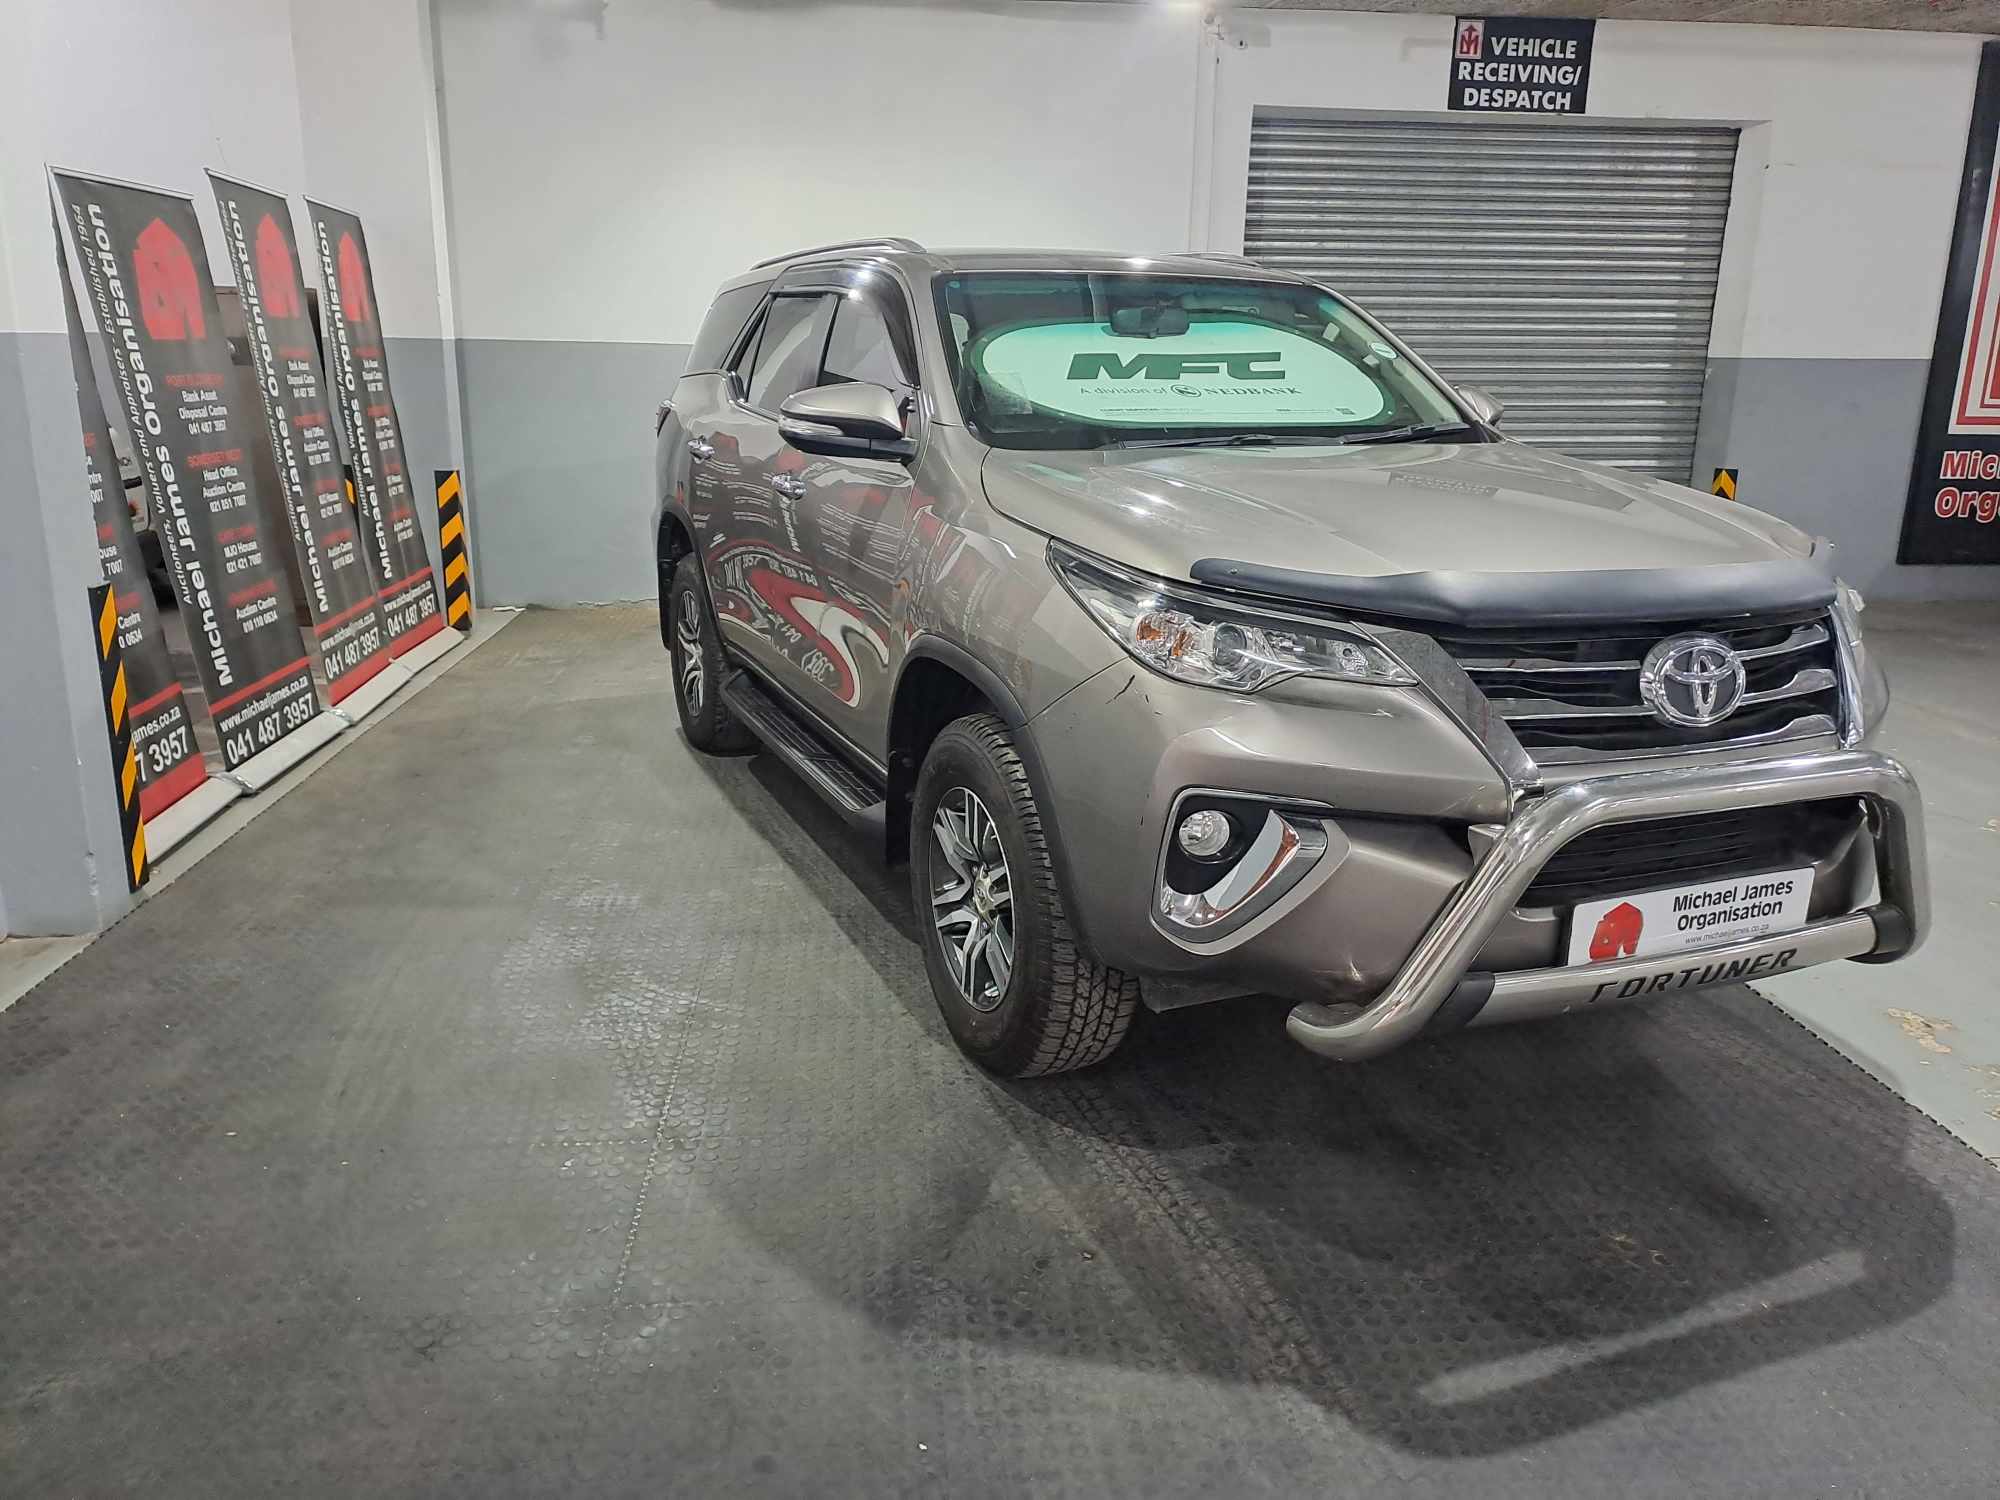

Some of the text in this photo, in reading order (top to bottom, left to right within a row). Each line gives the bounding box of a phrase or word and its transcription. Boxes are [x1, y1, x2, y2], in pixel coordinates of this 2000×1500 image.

[1457, 61, 1583, 86] RECEIVING/
[1490, 37, 1578, 59] VEHICLE
[1463, 87, 1572, 111] DESPATCH
[71, 203, 89, 242] 1964
[83, 247, 115, 335] Established
[228, 200, 279, 397] Organisation
[317, 221, 355, 391] Organisation
[87, 203, 162, 436] Organisation
[111, 347, 142, 426] Appraisers
[1066, 351, 1286, 381] MFC
[1201, 385, 1303, 396] NEDBANK
[133, 428, 150, 457] and
[275, 405, 303, 497] James
[350, 398, 374, 479] James
[145, 461, 166, 514] Valuers
[1940, 450, 2000, 480] Mic
[156, 445, 196, 551] James
[1935, 486, 2000, 523] Org
[365, 484, 393, 579] Michael
[296, 504, 329, 613] Michael
[117, 611, 142, 629] Centre
[185, 559, 233, 687] Michael
[387, 593, 436, 638] 041 487 3957
[324, 627, 380, 679] 041 487 3957
[219, 675, 309, 734] www.michaeljames.co.za
[226, 692, 315, 765] 041 487 3957
[149, 725, 189, 773] 3957
[1672, 880, 1794, 913] Michael James
[1677, 900, 1783, 931] Organisation
